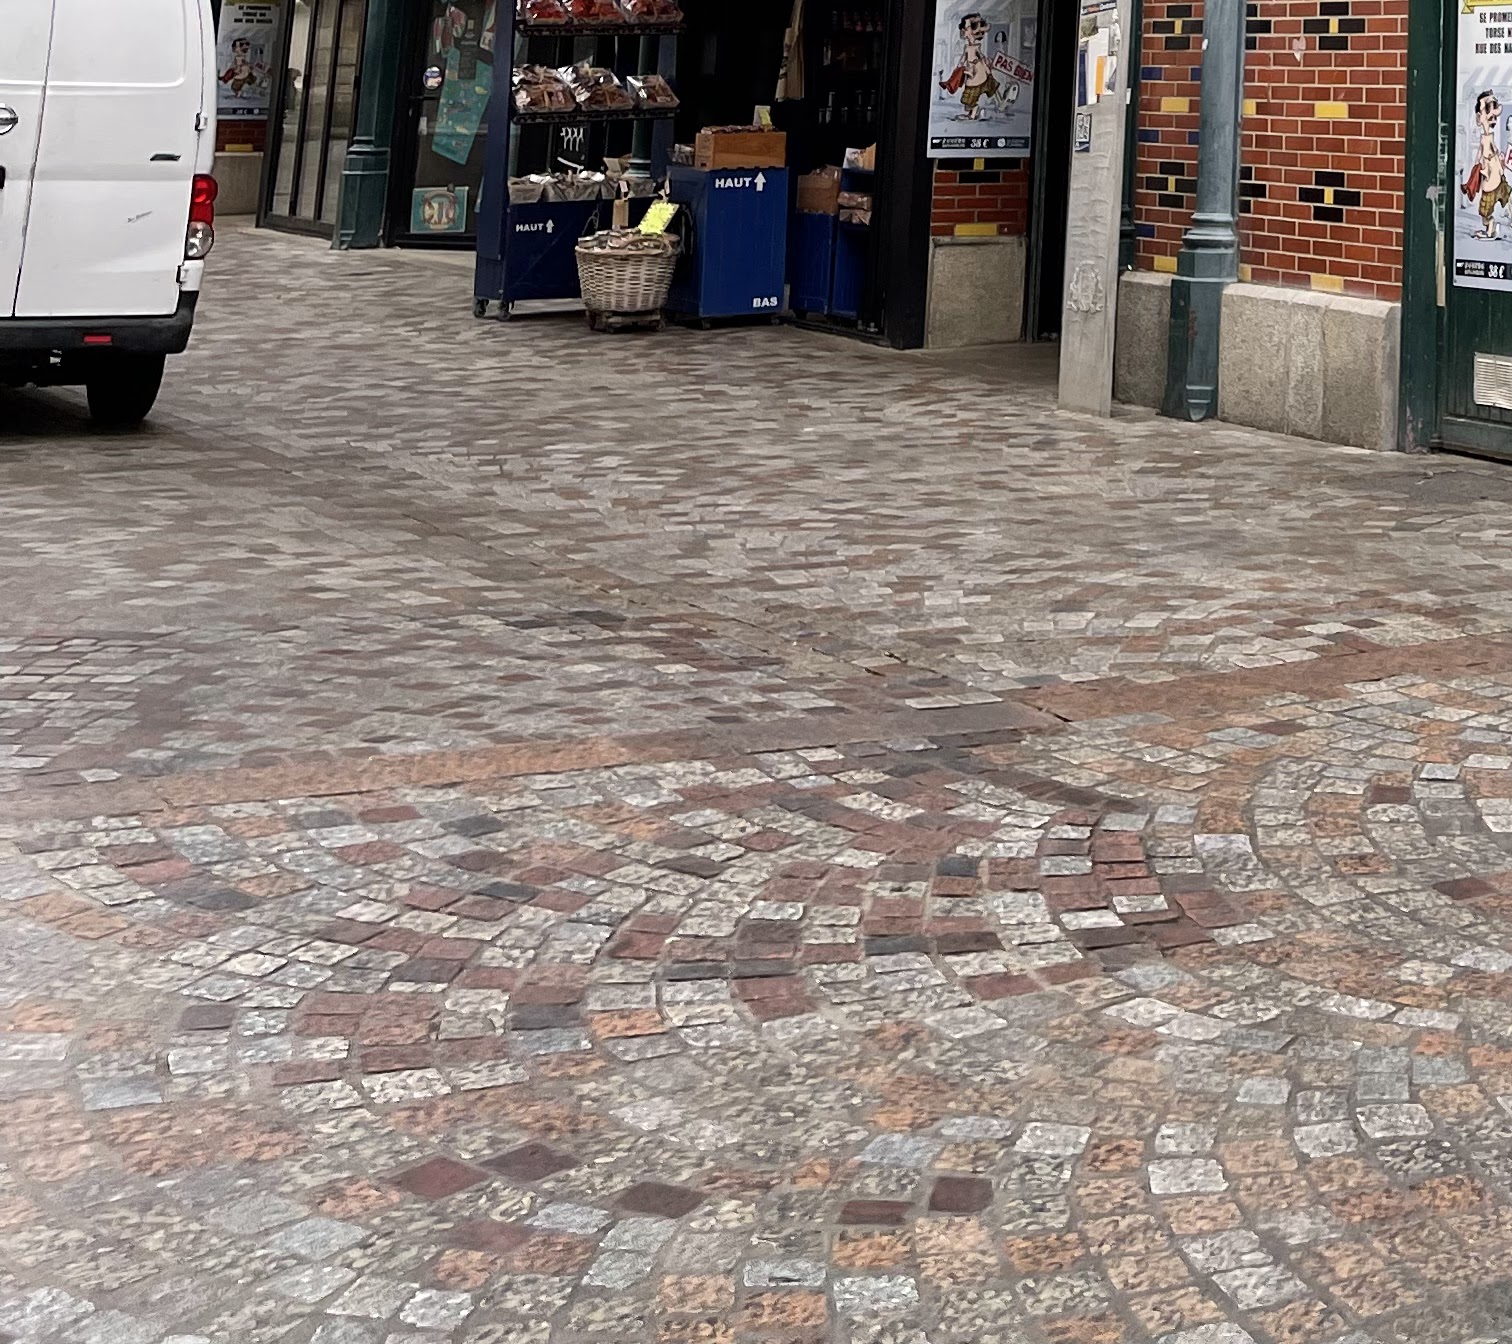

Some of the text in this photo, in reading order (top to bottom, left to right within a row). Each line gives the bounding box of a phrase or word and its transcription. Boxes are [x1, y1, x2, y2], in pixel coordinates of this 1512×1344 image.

[1480, 12, 1487, 23] SE
[1486, 27, 1505, 38] TORSE
[1475, 43, 1487, 54] RUE
[1490, 43, 1502, 54] DES
[995, 54, 1014, 72] PAS
[714, 177, 752, 189] HAUT
[515, 223, 544, 232] HAUT
[753, 297, 778, 308] BAS
